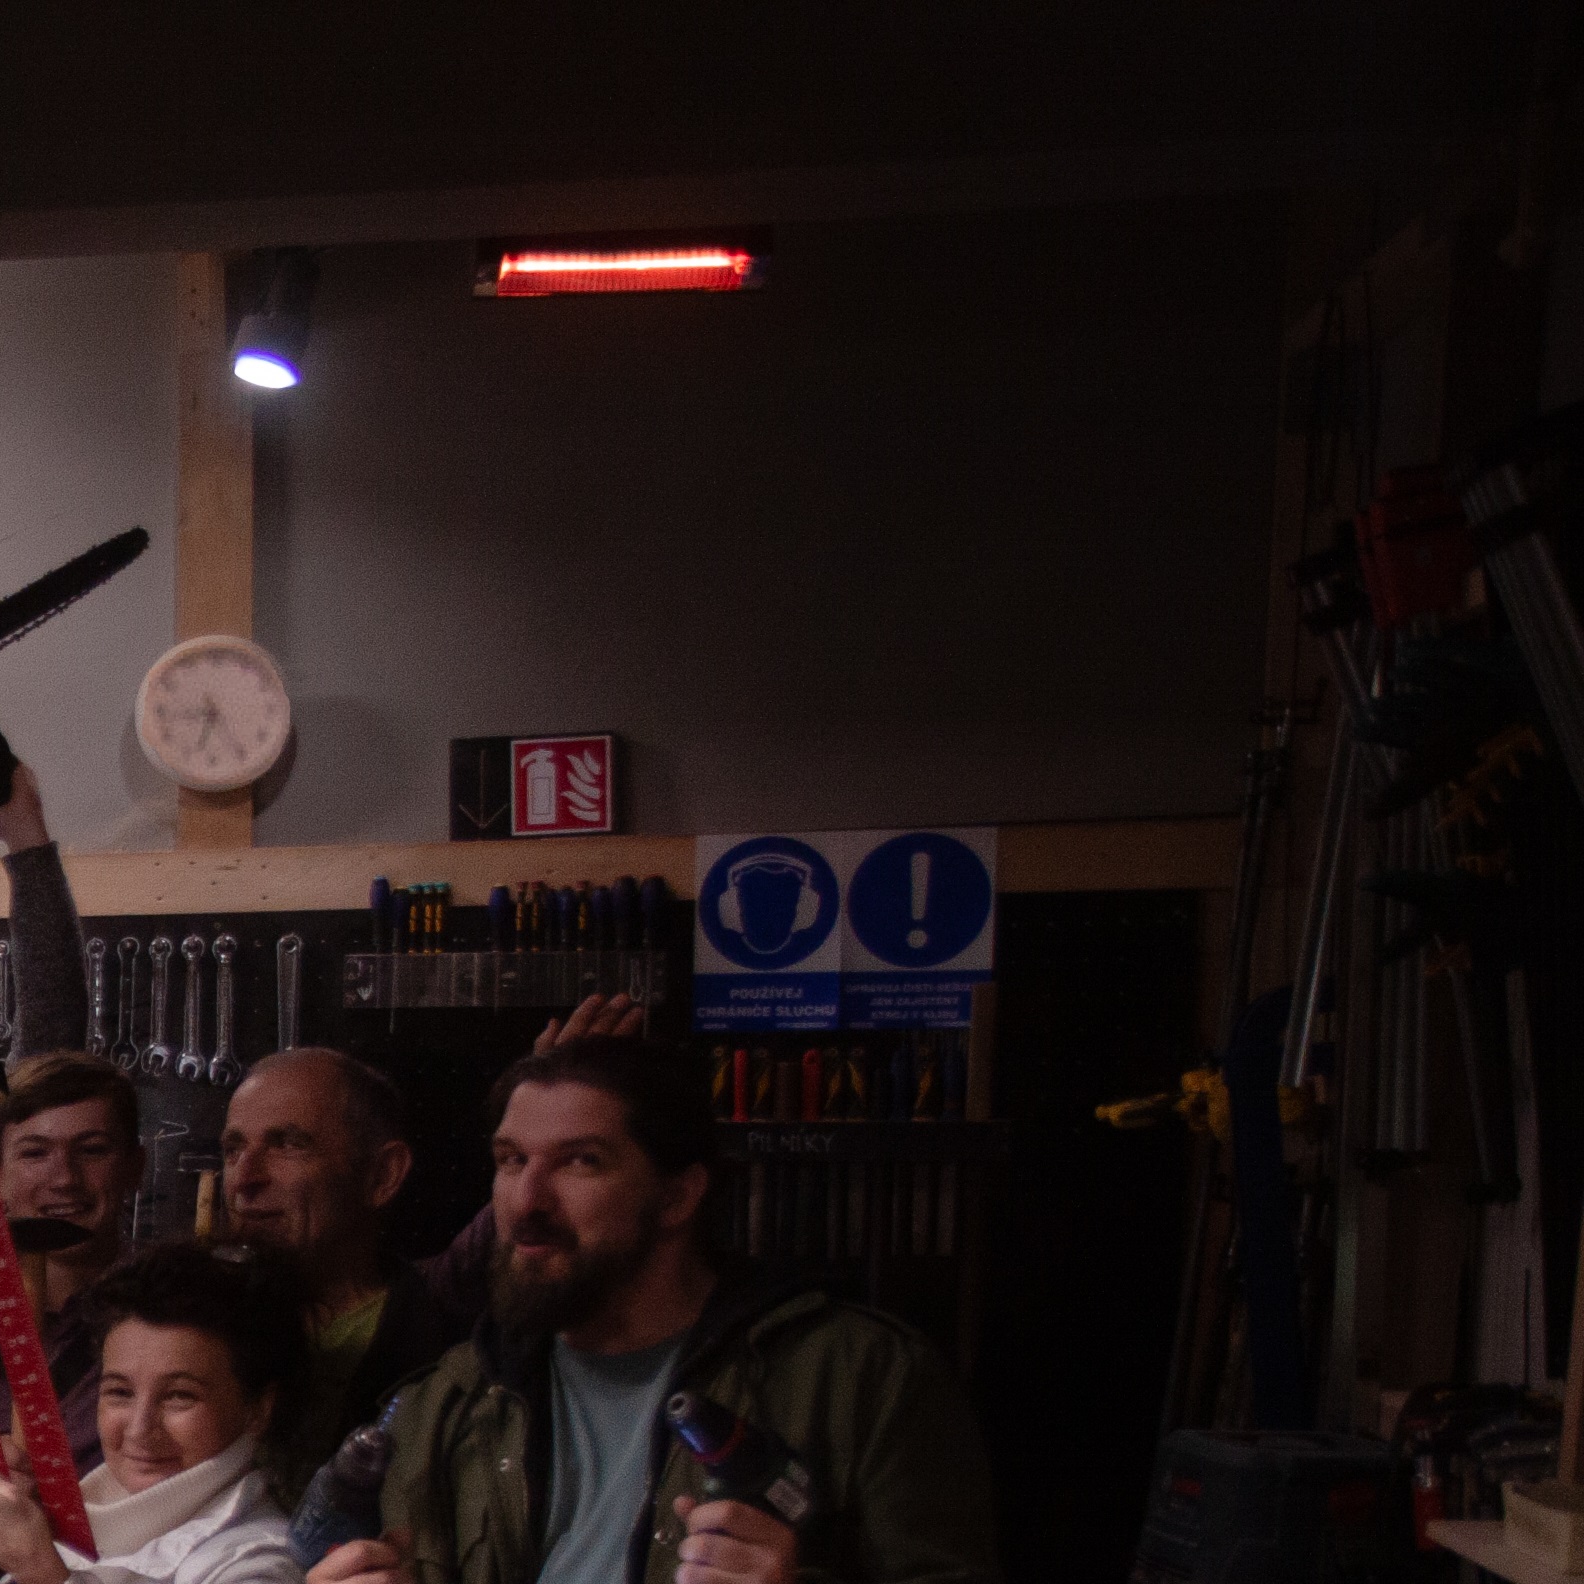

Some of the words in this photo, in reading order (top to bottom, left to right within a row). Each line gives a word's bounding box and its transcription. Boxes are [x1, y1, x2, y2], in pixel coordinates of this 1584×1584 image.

[729, 985, 803, 1000] POUŽÍVEJ
[696, 1004, 772, 1018] CHRÁNIČE
[775, 1005, 837, 1017] SLUCHU
